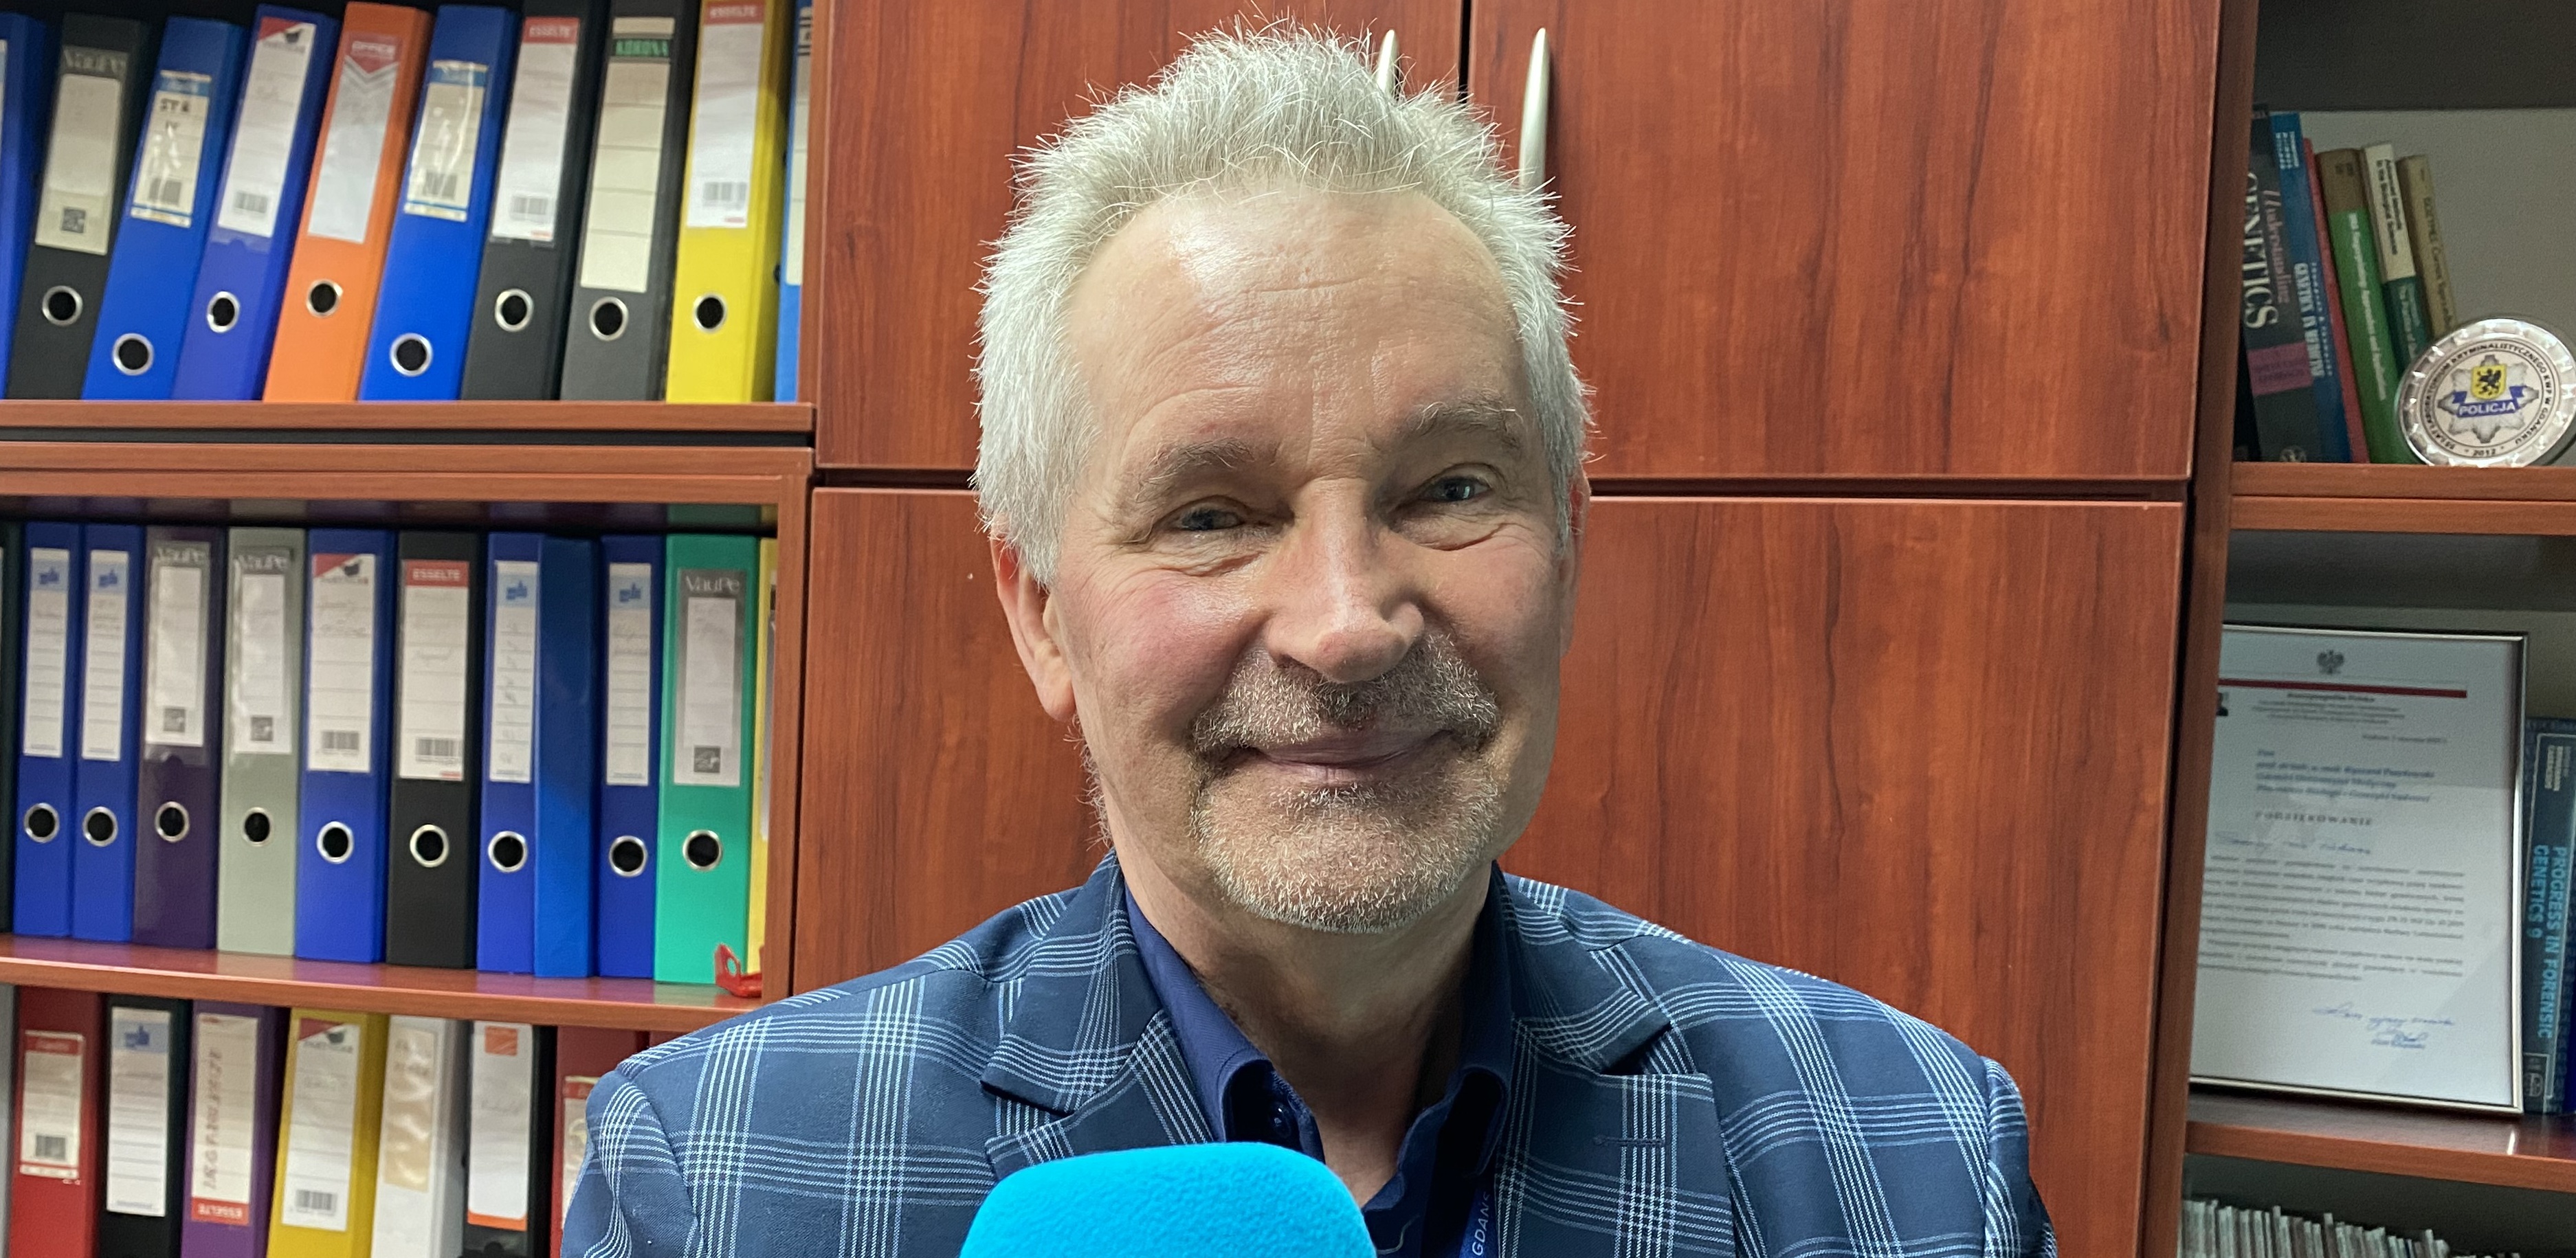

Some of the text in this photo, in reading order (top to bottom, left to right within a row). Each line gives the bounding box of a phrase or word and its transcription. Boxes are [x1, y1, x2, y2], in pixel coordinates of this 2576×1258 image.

[529, 25, 570, 38] ESSELTE
[616, 38, 669, 57] KORONA
[2263, 190, 2291, 304] Understanding
[2542, 374, 2553, 394] KWP
[2458, 402, 2516, 416] POLICJA
[2473, 448, 2497, 456] 2012
[412, 568, 461, 581] ESSELTE
[685, 575, 741, 594] VauPe
[2526, 844, 2549, 939] GENETICS 9
[2537, 846, 2568, 1039] PROGRESS IN FORENSIC
